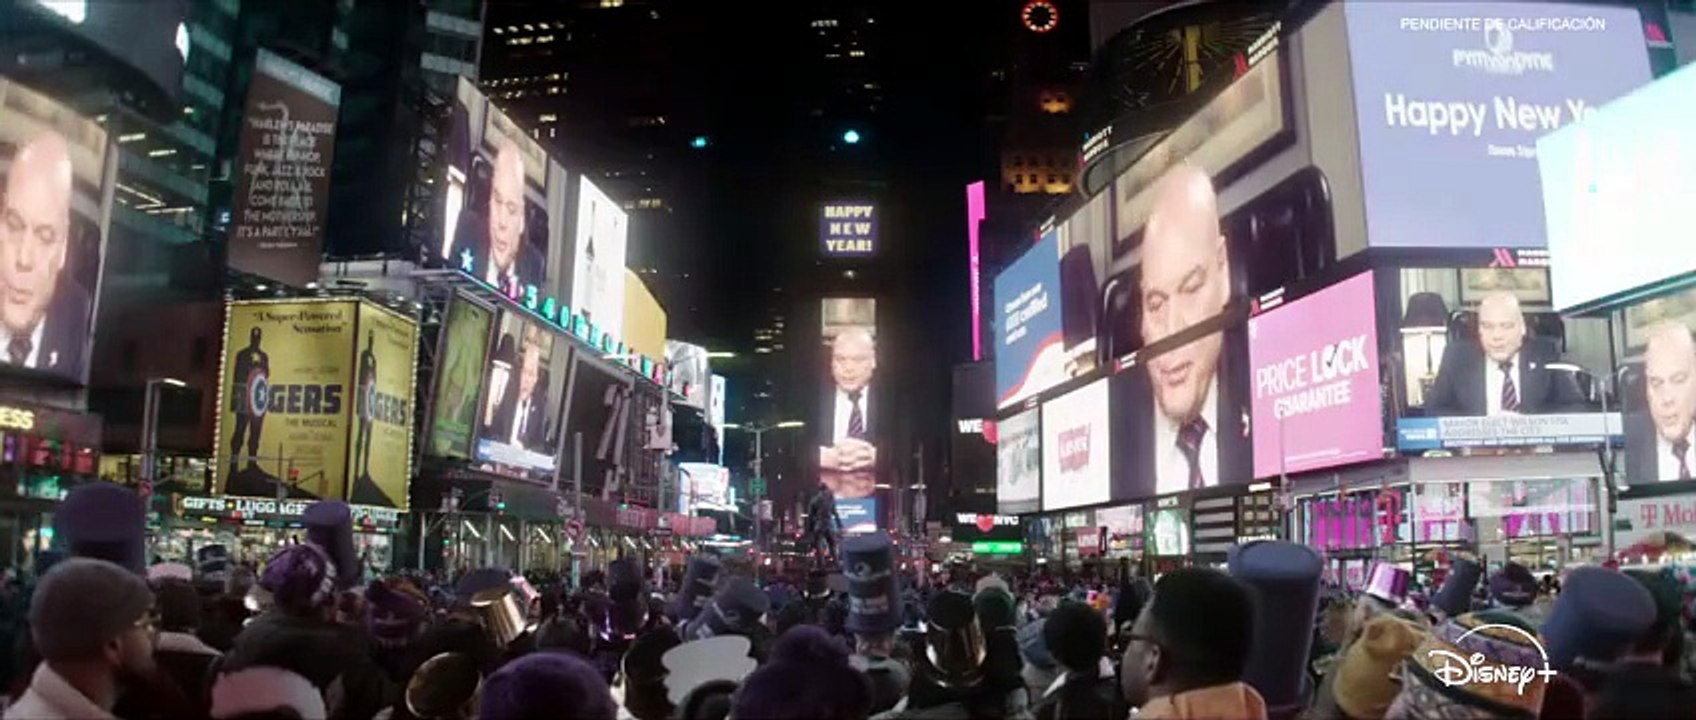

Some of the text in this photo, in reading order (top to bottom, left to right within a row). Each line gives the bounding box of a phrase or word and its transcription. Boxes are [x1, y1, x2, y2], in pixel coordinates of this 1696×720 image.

[1384, 92, 1486, 136] Happy
[1494, 95, 1561, 131] New
[824, 205, 874, 218] HAPPY
[830, 222, 872, 236] NEW
[826, 239, 873, 252] YEAR!
[1256, 333, 1370, 399] PRICE LOCK
[1273, 379, 1353, 421] GUARANTEE
[958, 418, 984, 434] WE
[183, 496, 226, 512] GIFTS
[956, 513, 1019, 526] WE NYC
